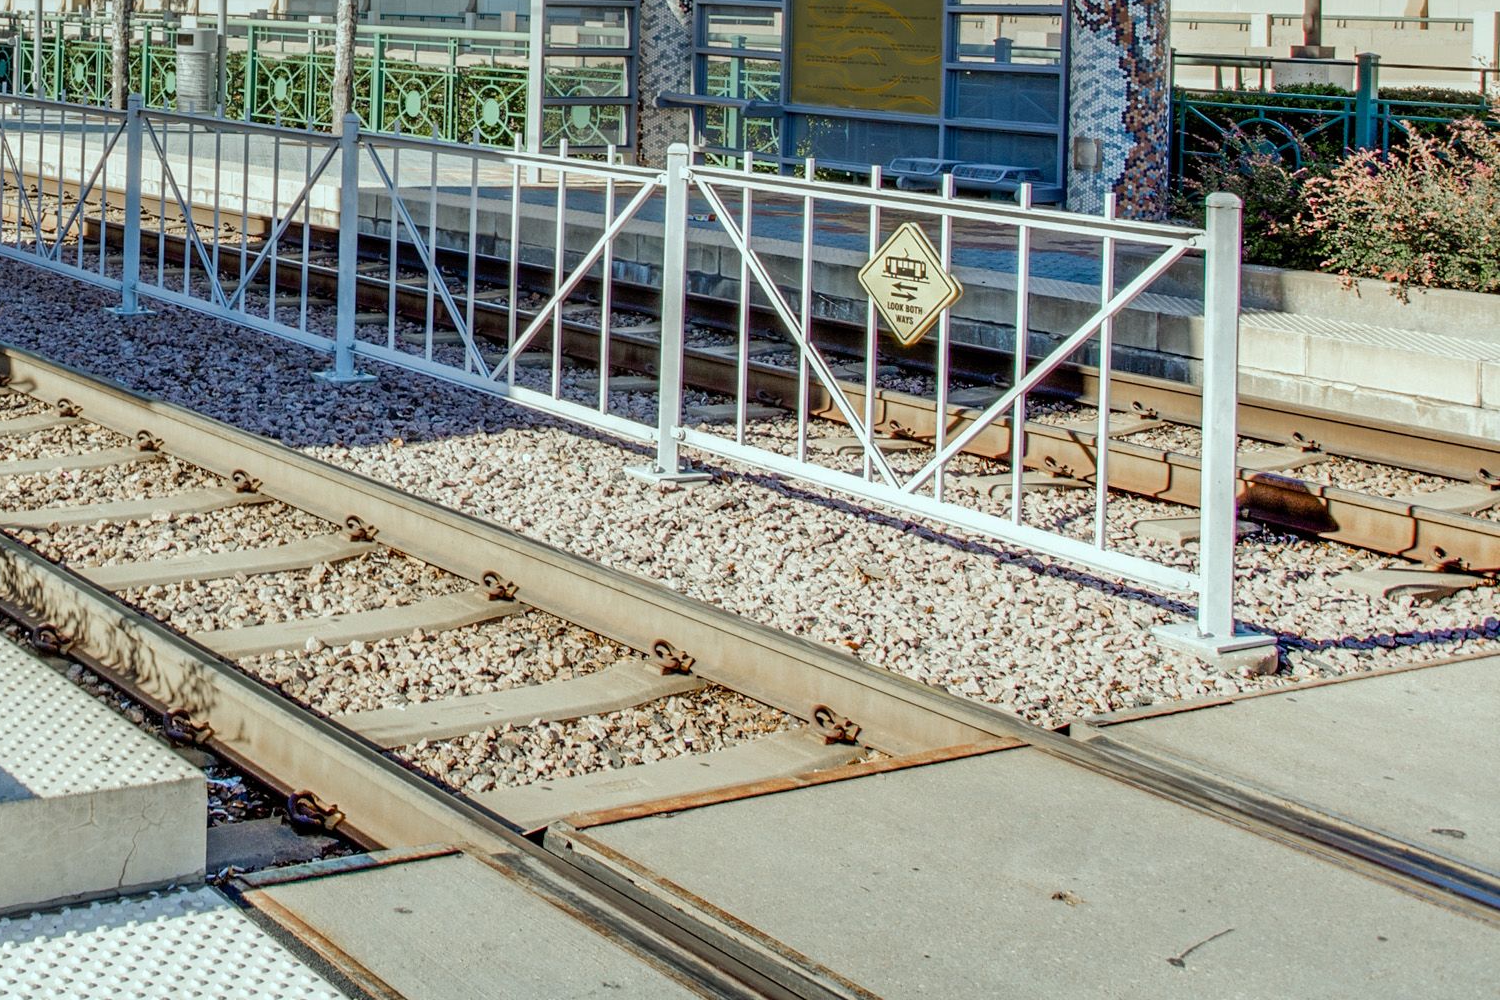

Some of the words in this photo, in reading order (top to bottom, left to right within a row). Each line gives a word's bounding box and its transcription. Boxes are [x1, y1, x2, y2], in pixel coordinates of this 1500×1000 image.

[887, 301, 904, 312] LOOK
[905, 305, 923, 315] BOTH
[896, 314, 914, 325] WAYS
